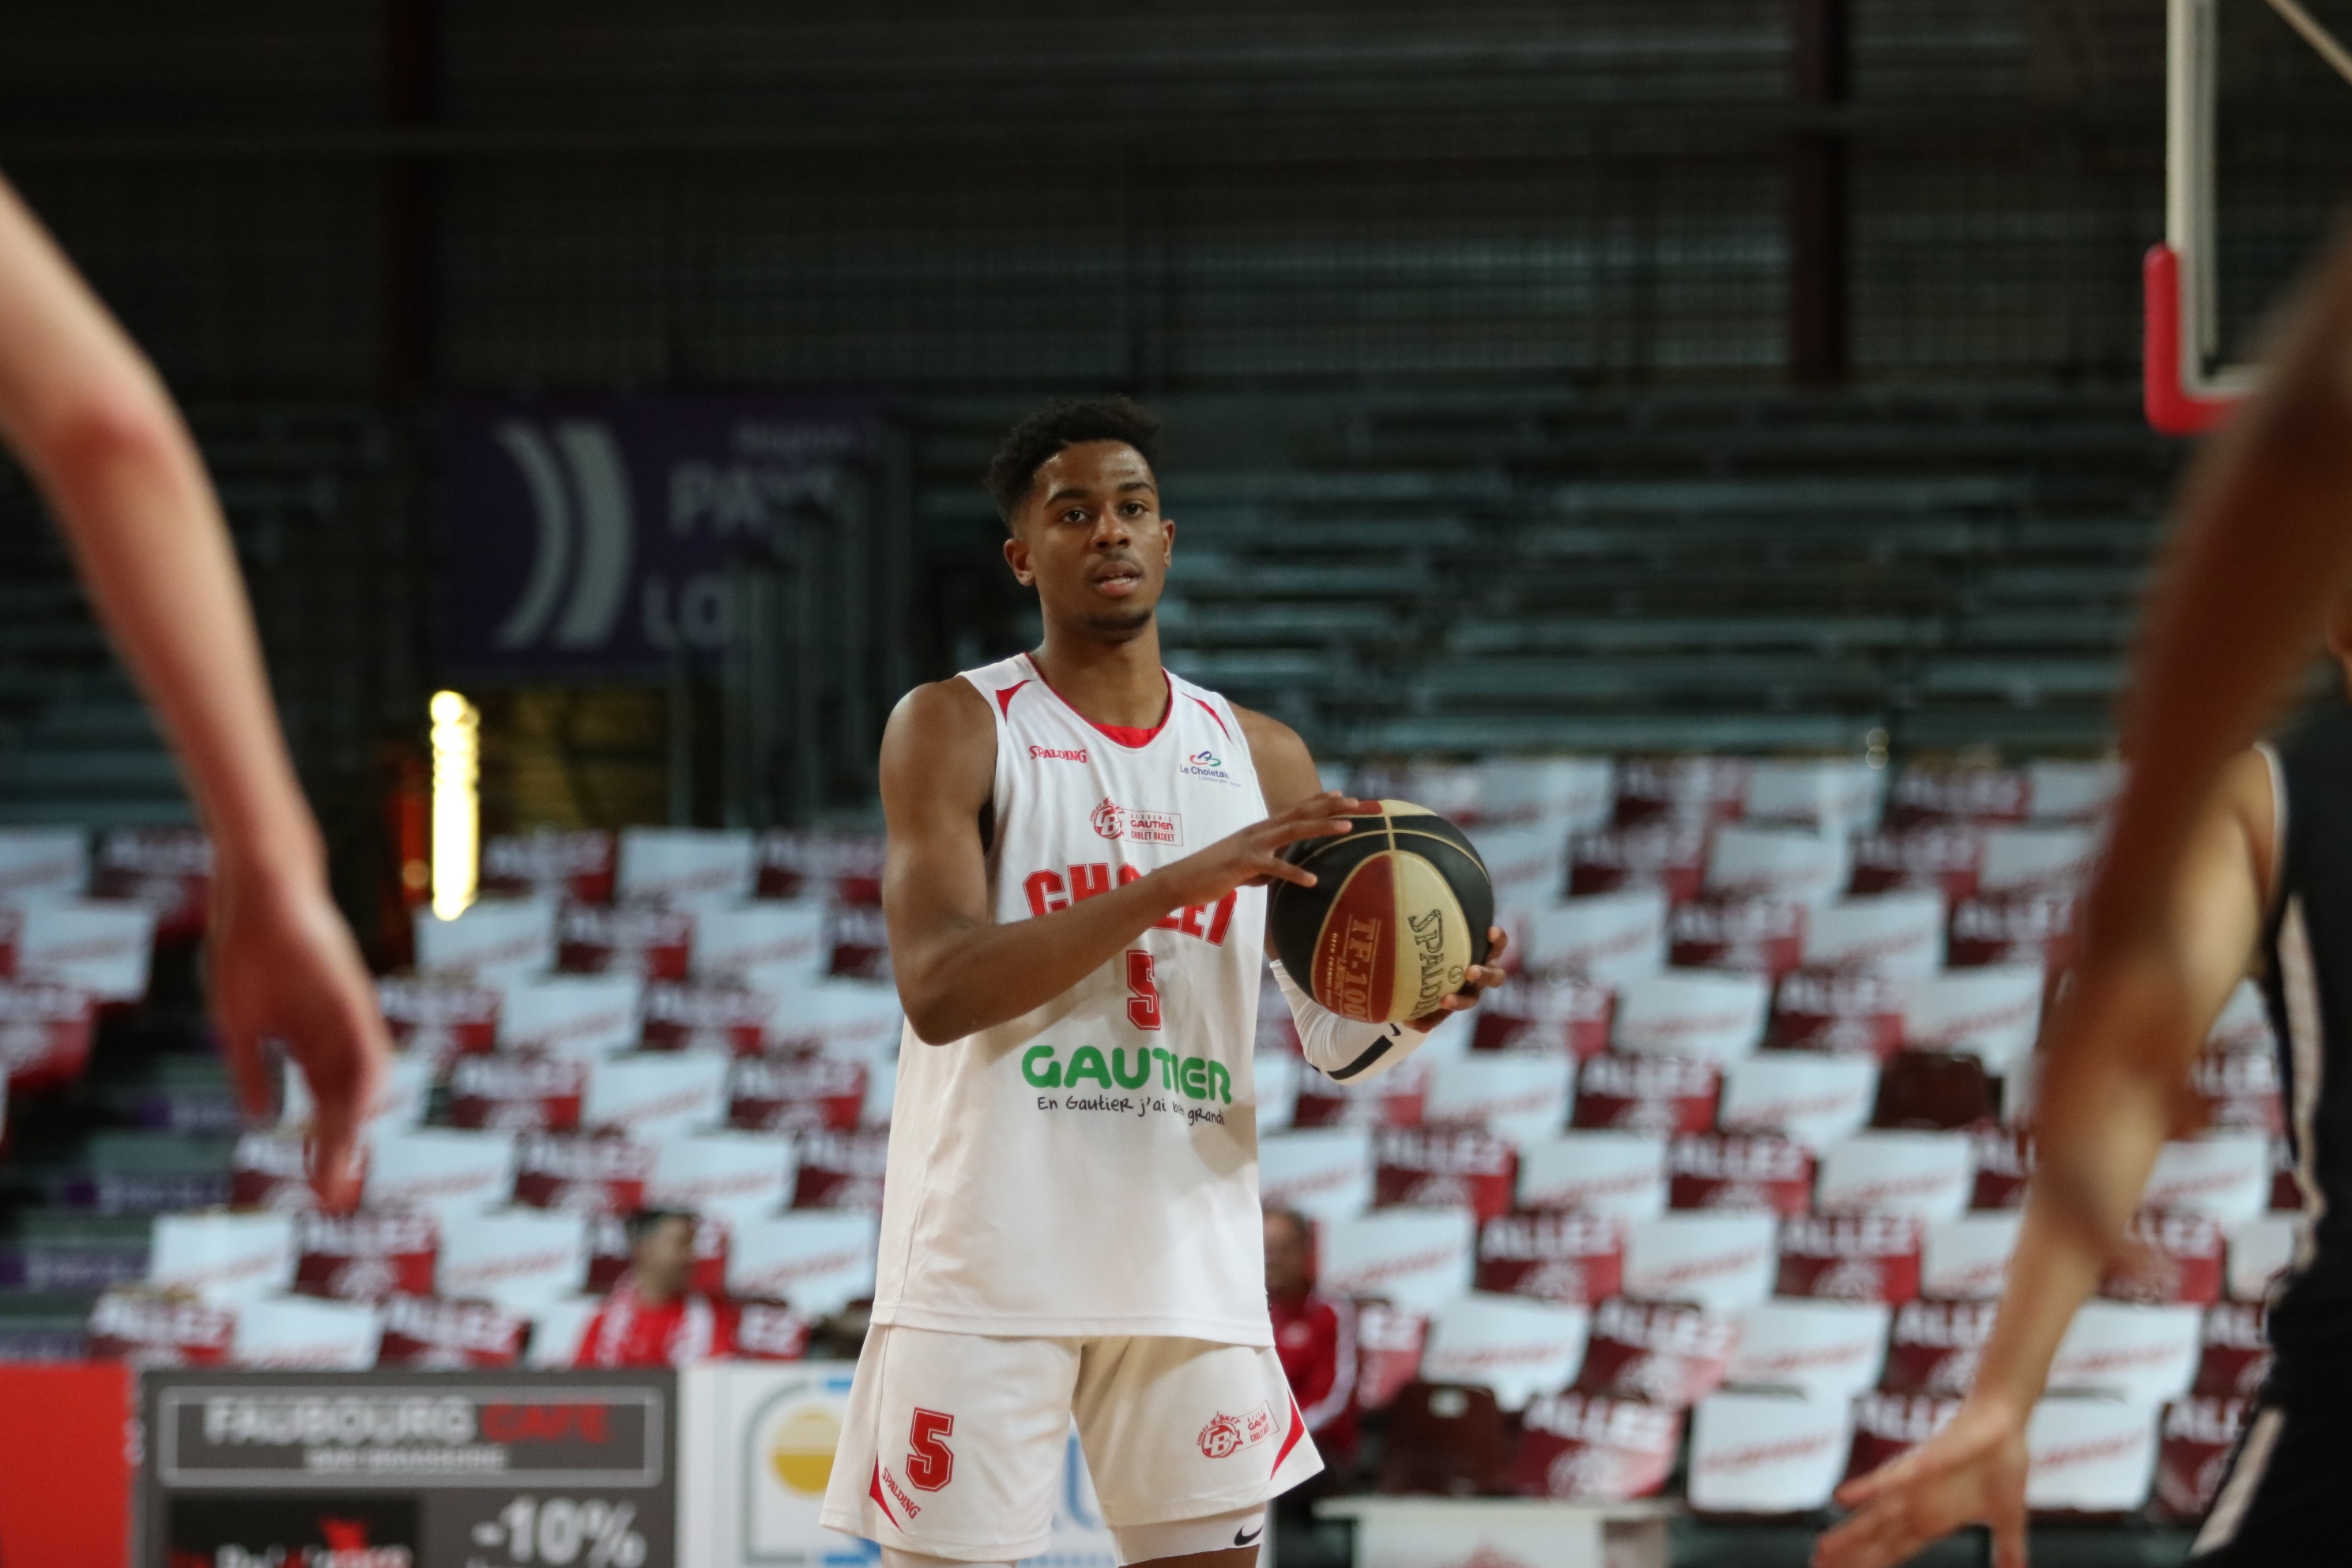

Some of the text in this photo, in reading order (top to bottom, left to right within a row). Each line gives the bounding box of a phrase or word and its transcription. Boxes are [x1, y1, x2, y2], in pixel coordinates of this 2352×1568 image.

[1028, 745, 1087, 764] SPALDING
[1179, 763, 1189, 774] Le
[1129, 820, 1174, 831] GAUTIER
[1130, 830, 1174, 842] CHOLET BASKET
[1407, 909, 1444, 1018] SPALDIN
[1126, 949, 1162, 1031] 5
[1021, 1045, 1232, 1105] GAUTIER
[1037, 1096, 1058, 1111] En
[1137, 1096, 1167, 1117] j'ai
[203, 1395, 476, 1446] FAUBOURG
[905, 1407, 955, 1493] 5
[881, 1466, 922, 1520] SPALDING
[473, 1494, 648, 1565] -10%
